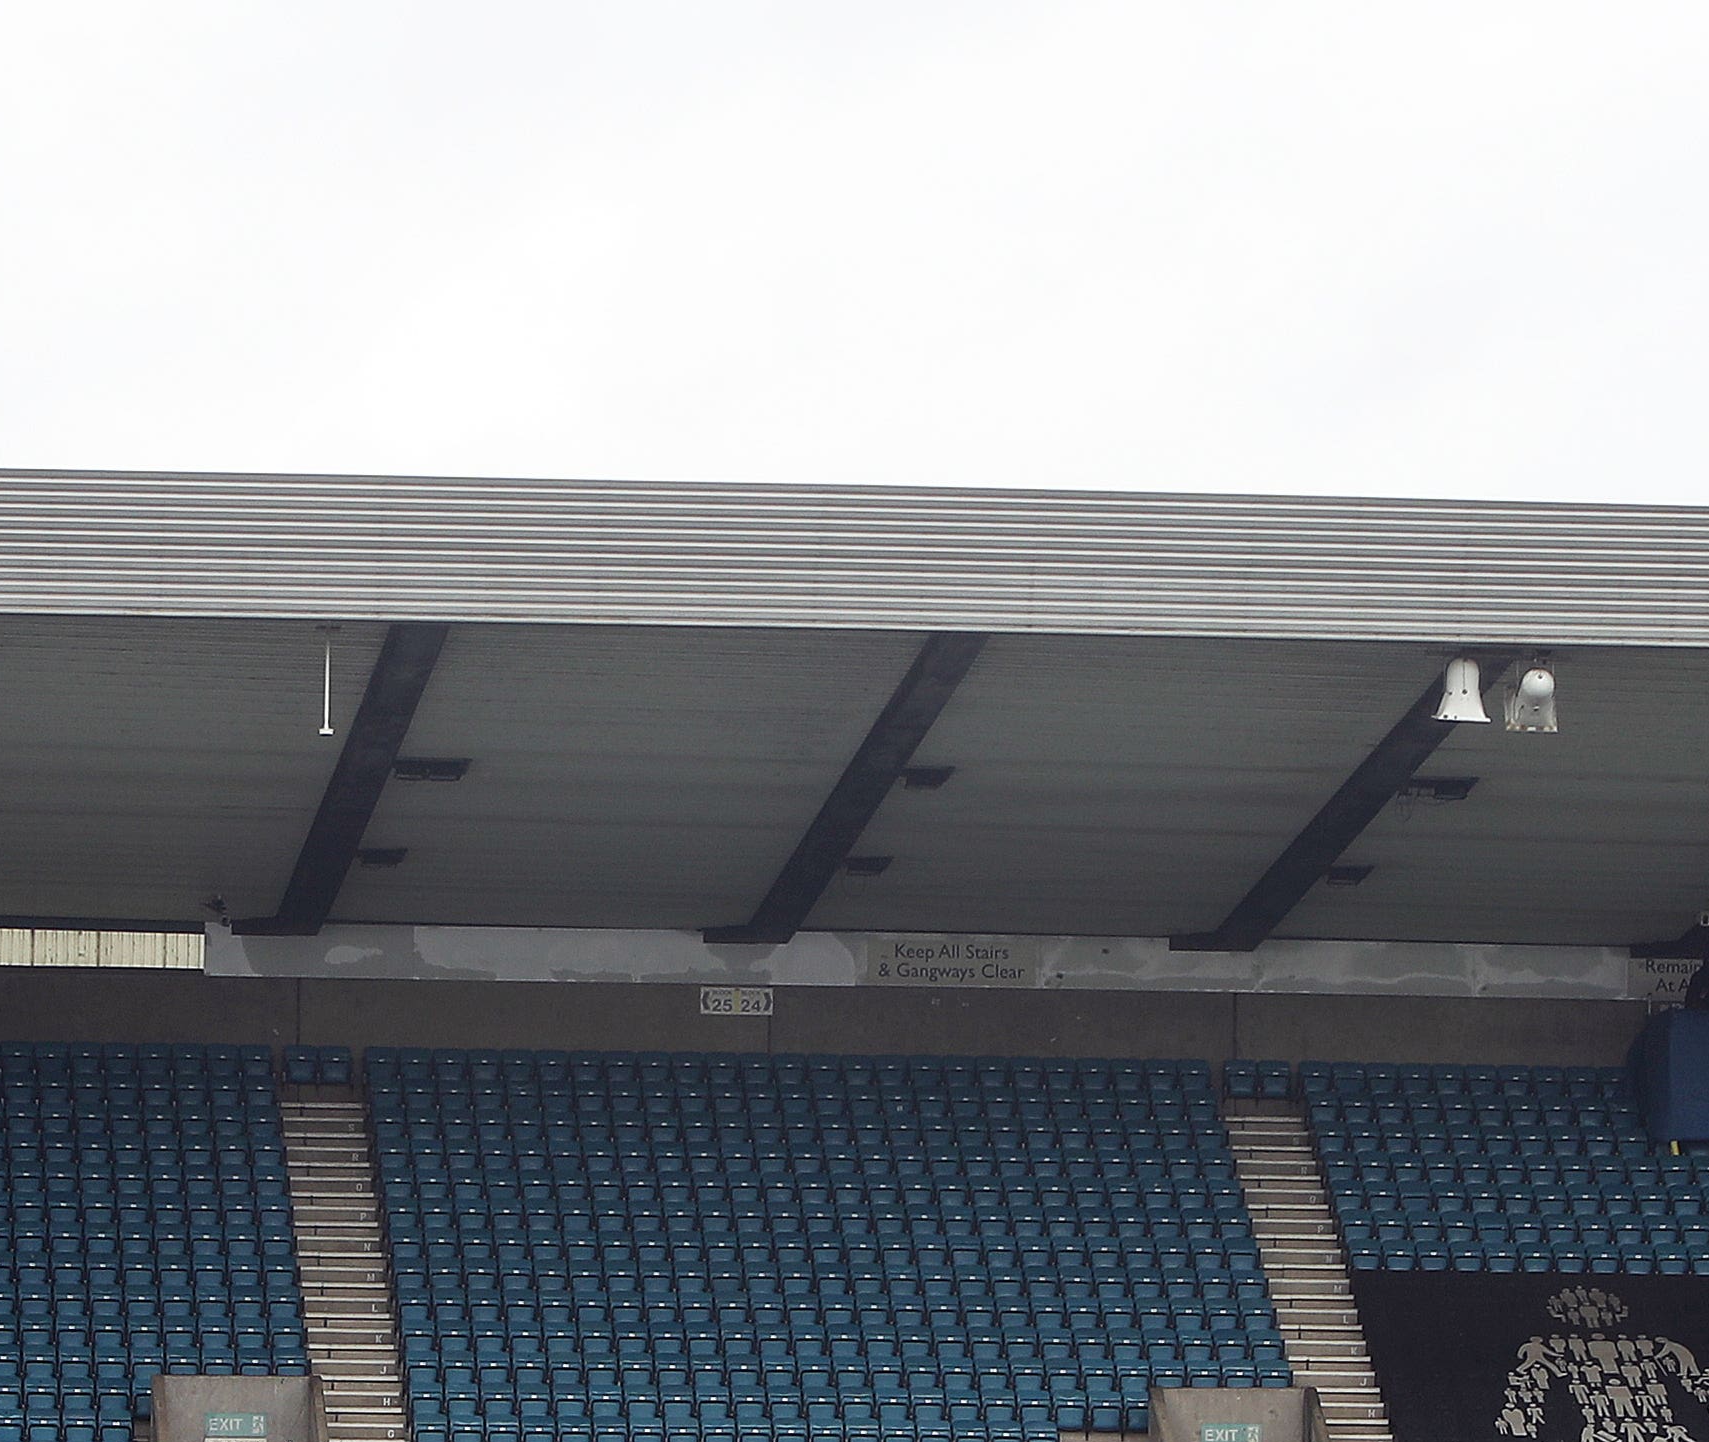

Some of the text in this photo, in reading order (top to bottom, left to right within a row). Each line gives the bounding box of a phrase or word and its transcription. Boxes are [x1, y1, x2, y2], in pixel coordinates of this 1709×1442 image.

[895, 943, 1009, 962] Keep All Stairs
[878, 963, 1025, 982] & Gangways Clear
[712, 999, 762, 1013] 25 24
[209, 1418, 243, 1431] EXIT
[1205, 1429, 1238, 1442] EXIT
